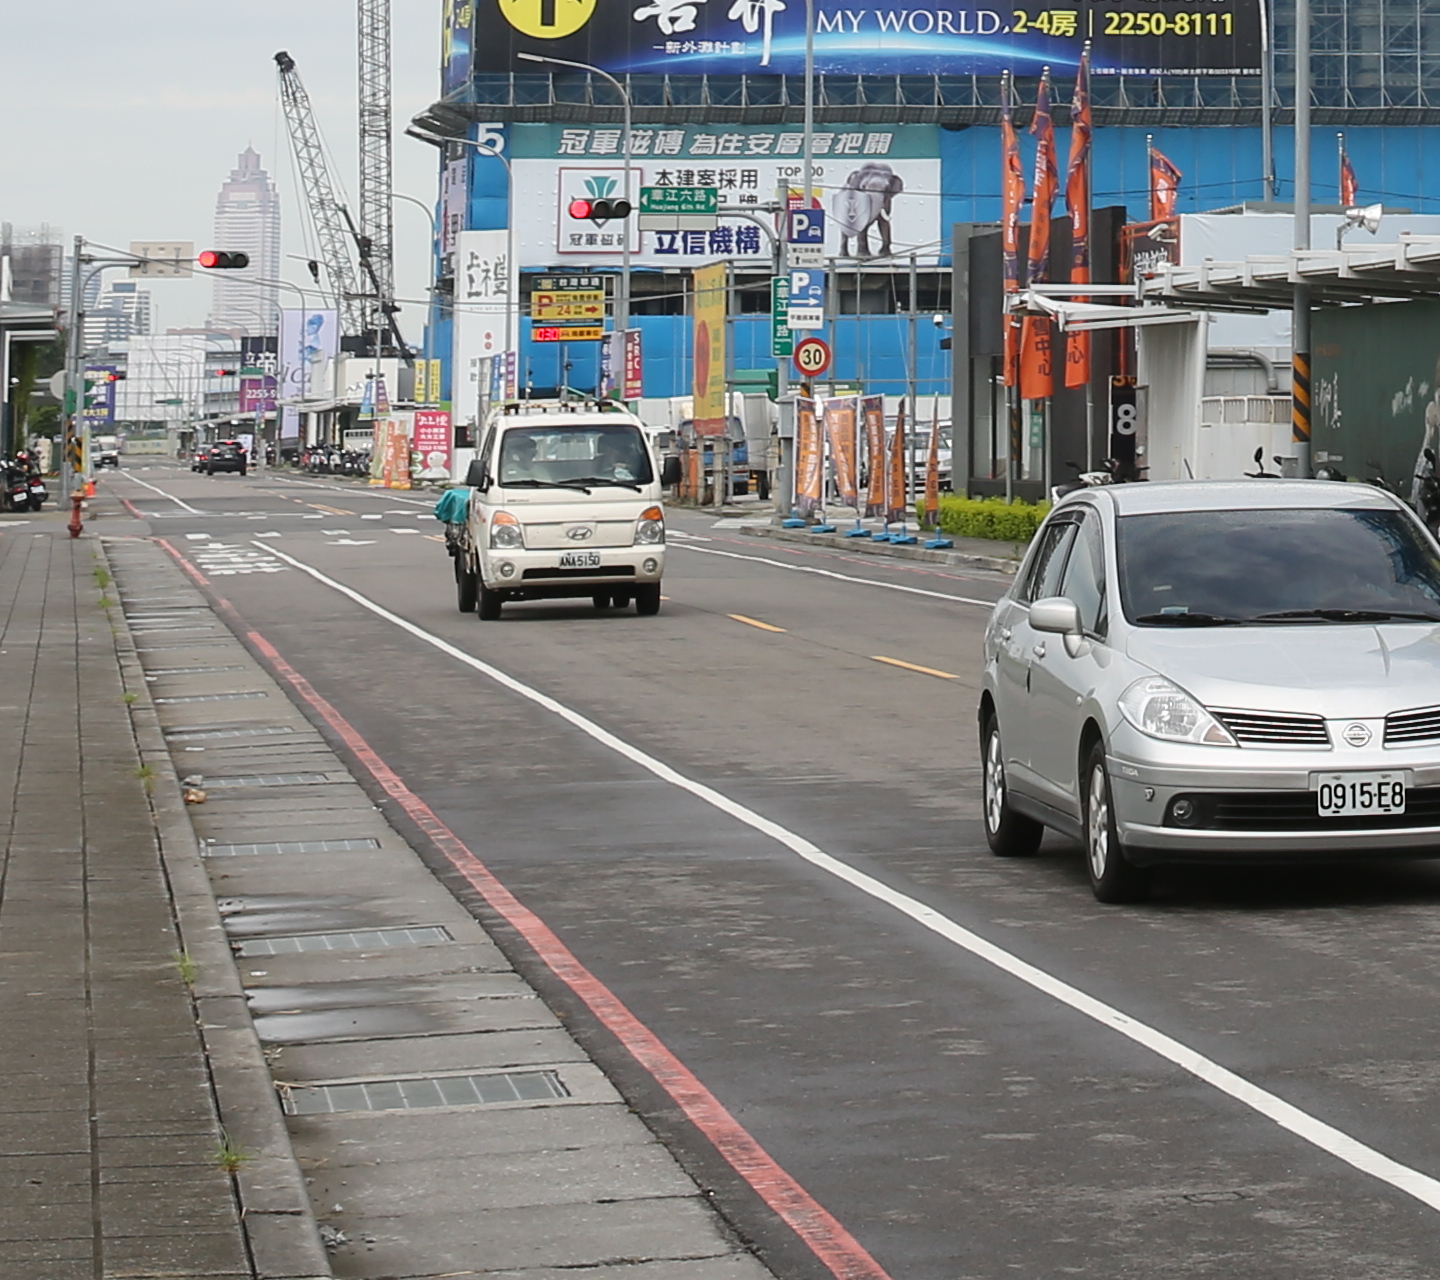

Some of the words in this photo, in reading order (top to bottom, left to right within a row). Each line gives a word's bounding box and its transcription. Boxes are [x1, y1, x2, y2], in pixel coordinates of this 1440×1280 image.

[815, 9, 873, 35] MY
[1103, 10, 1235, 37] 2250-8111
[476, 122, 506, 157] 5
[775, 166, 802, 177] TOP
[653, 225, 761, 255] 立信機構
[792, 213, 810, 240] P
[791, 272, 810, 295] P
[802, 348, 823, 366] 30
